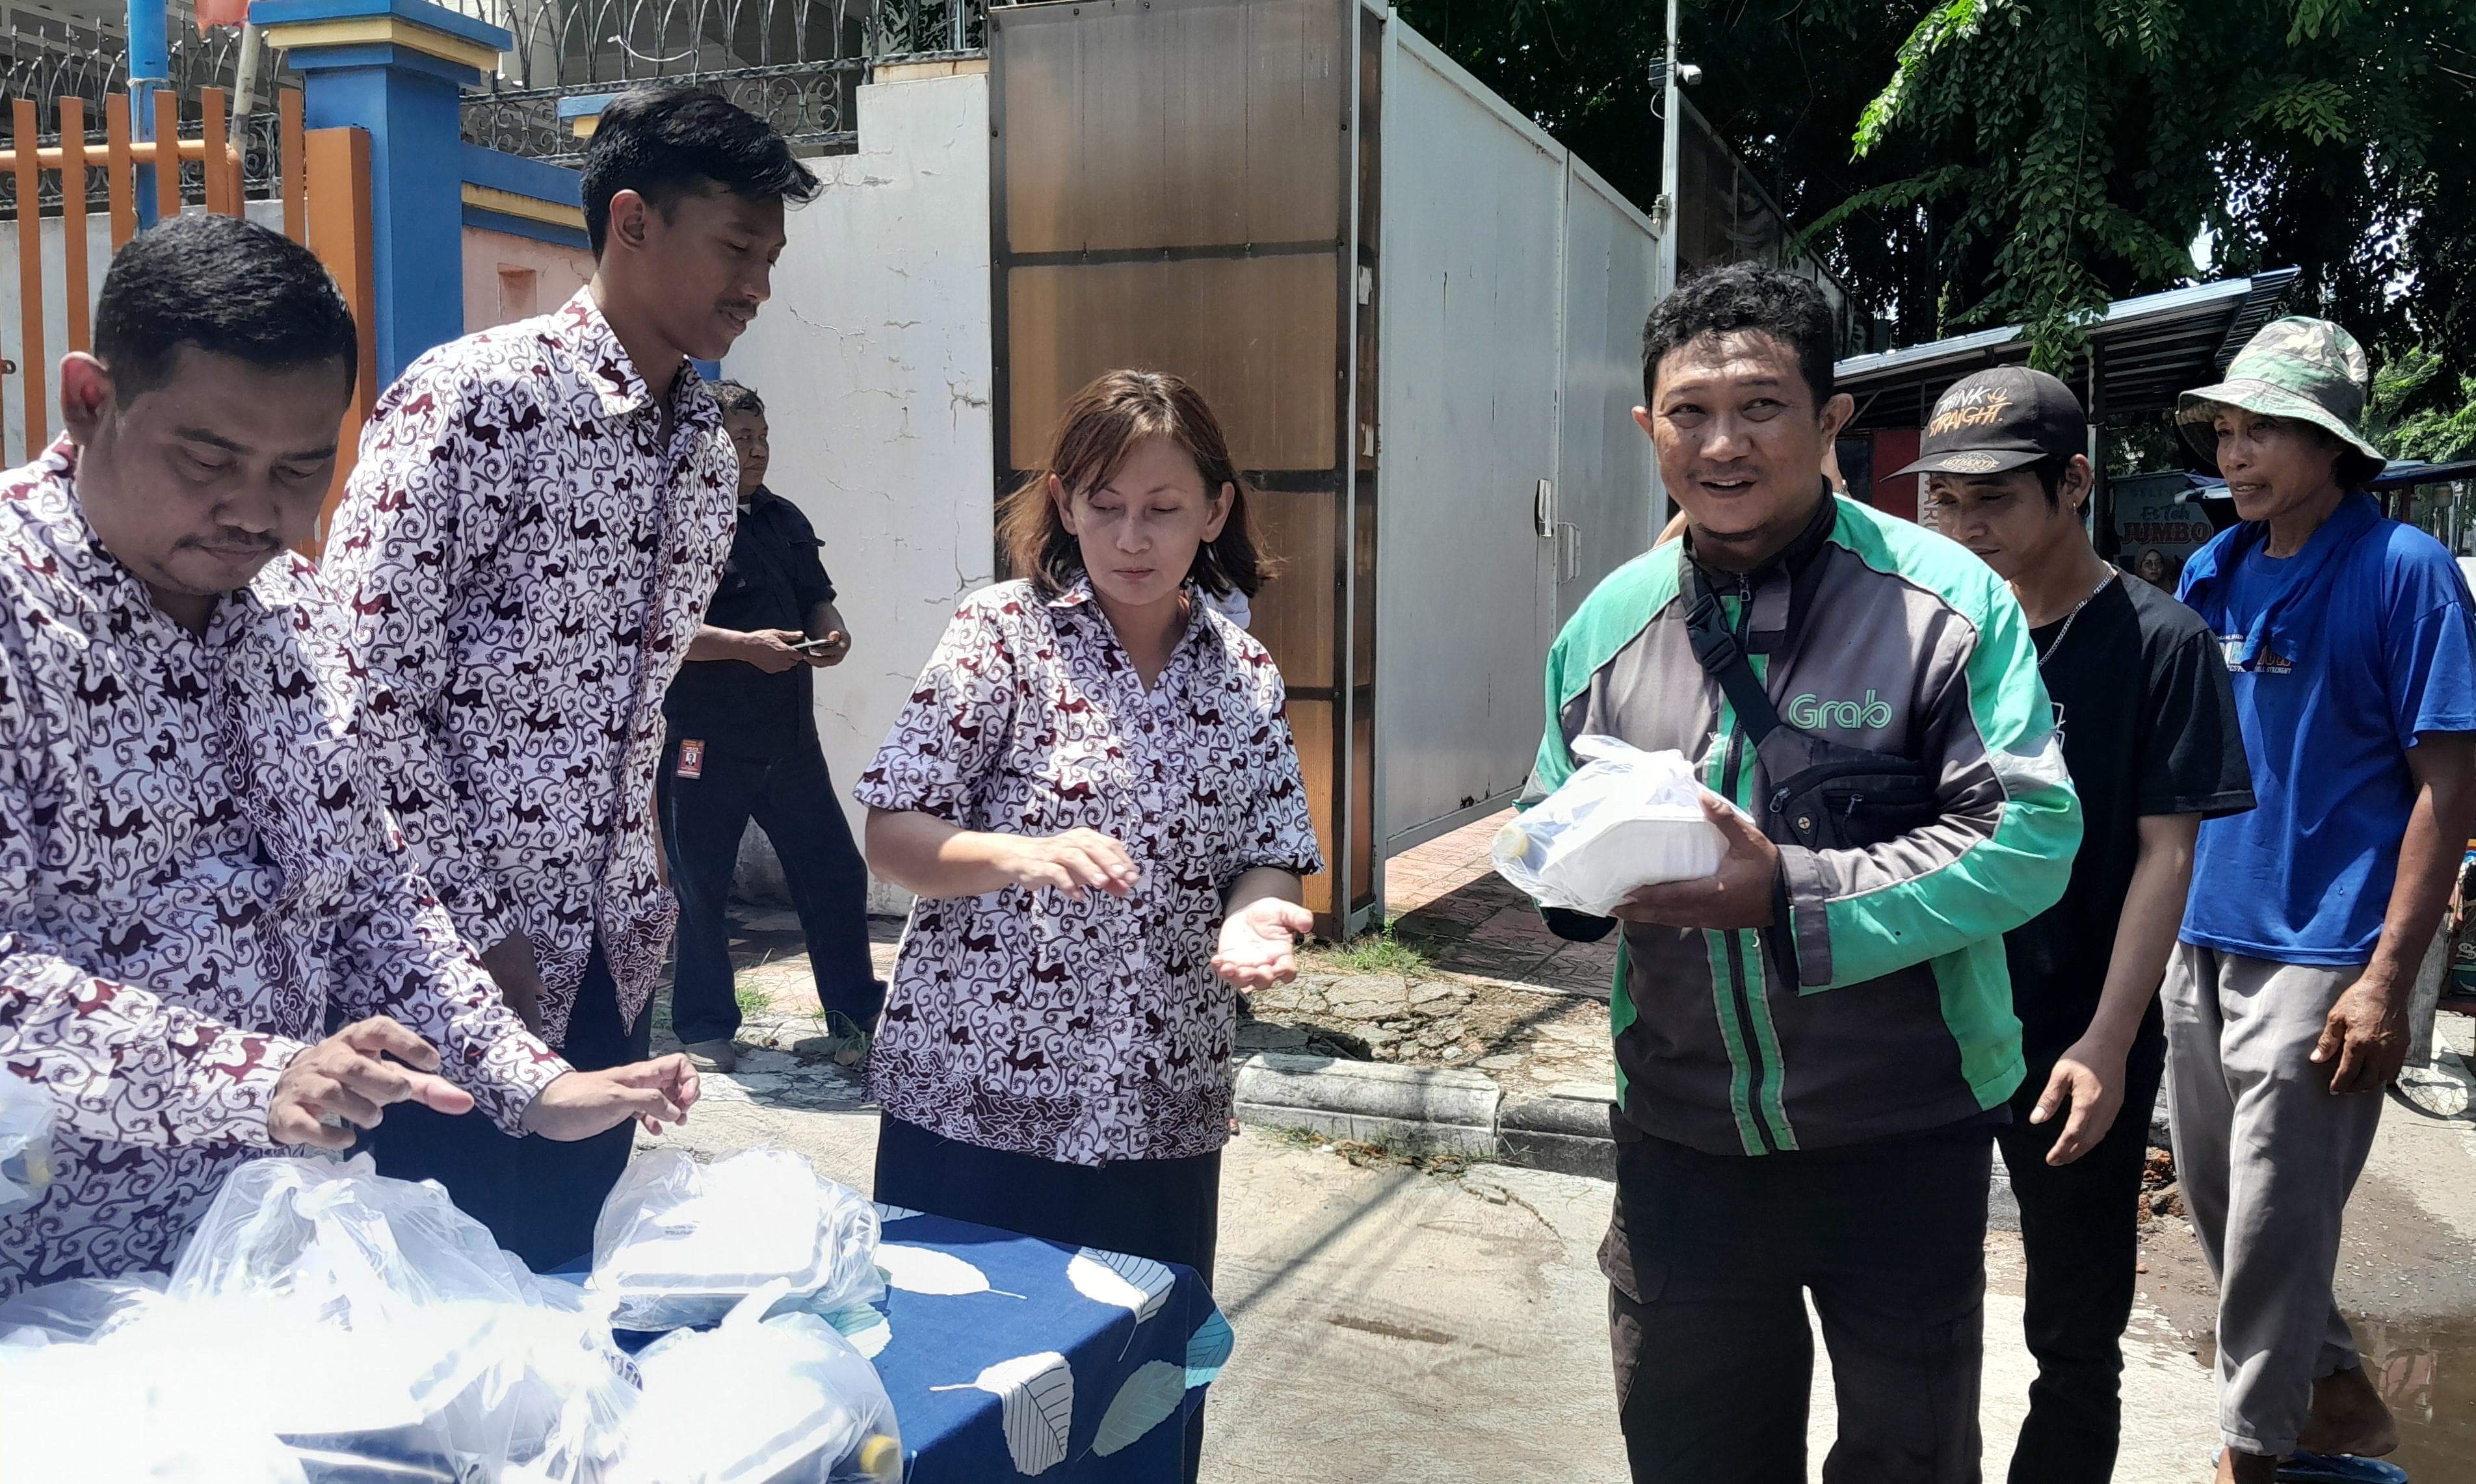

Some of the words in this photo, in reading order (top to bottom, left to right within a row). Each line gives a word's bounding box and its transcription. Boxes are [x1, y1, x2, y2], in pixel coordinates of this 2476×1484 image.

[1936, 386, 1992, 417] THINK
[2120, 522, 2213, 544] JUMBO
[1788, 689, 1892, 729] Grab
